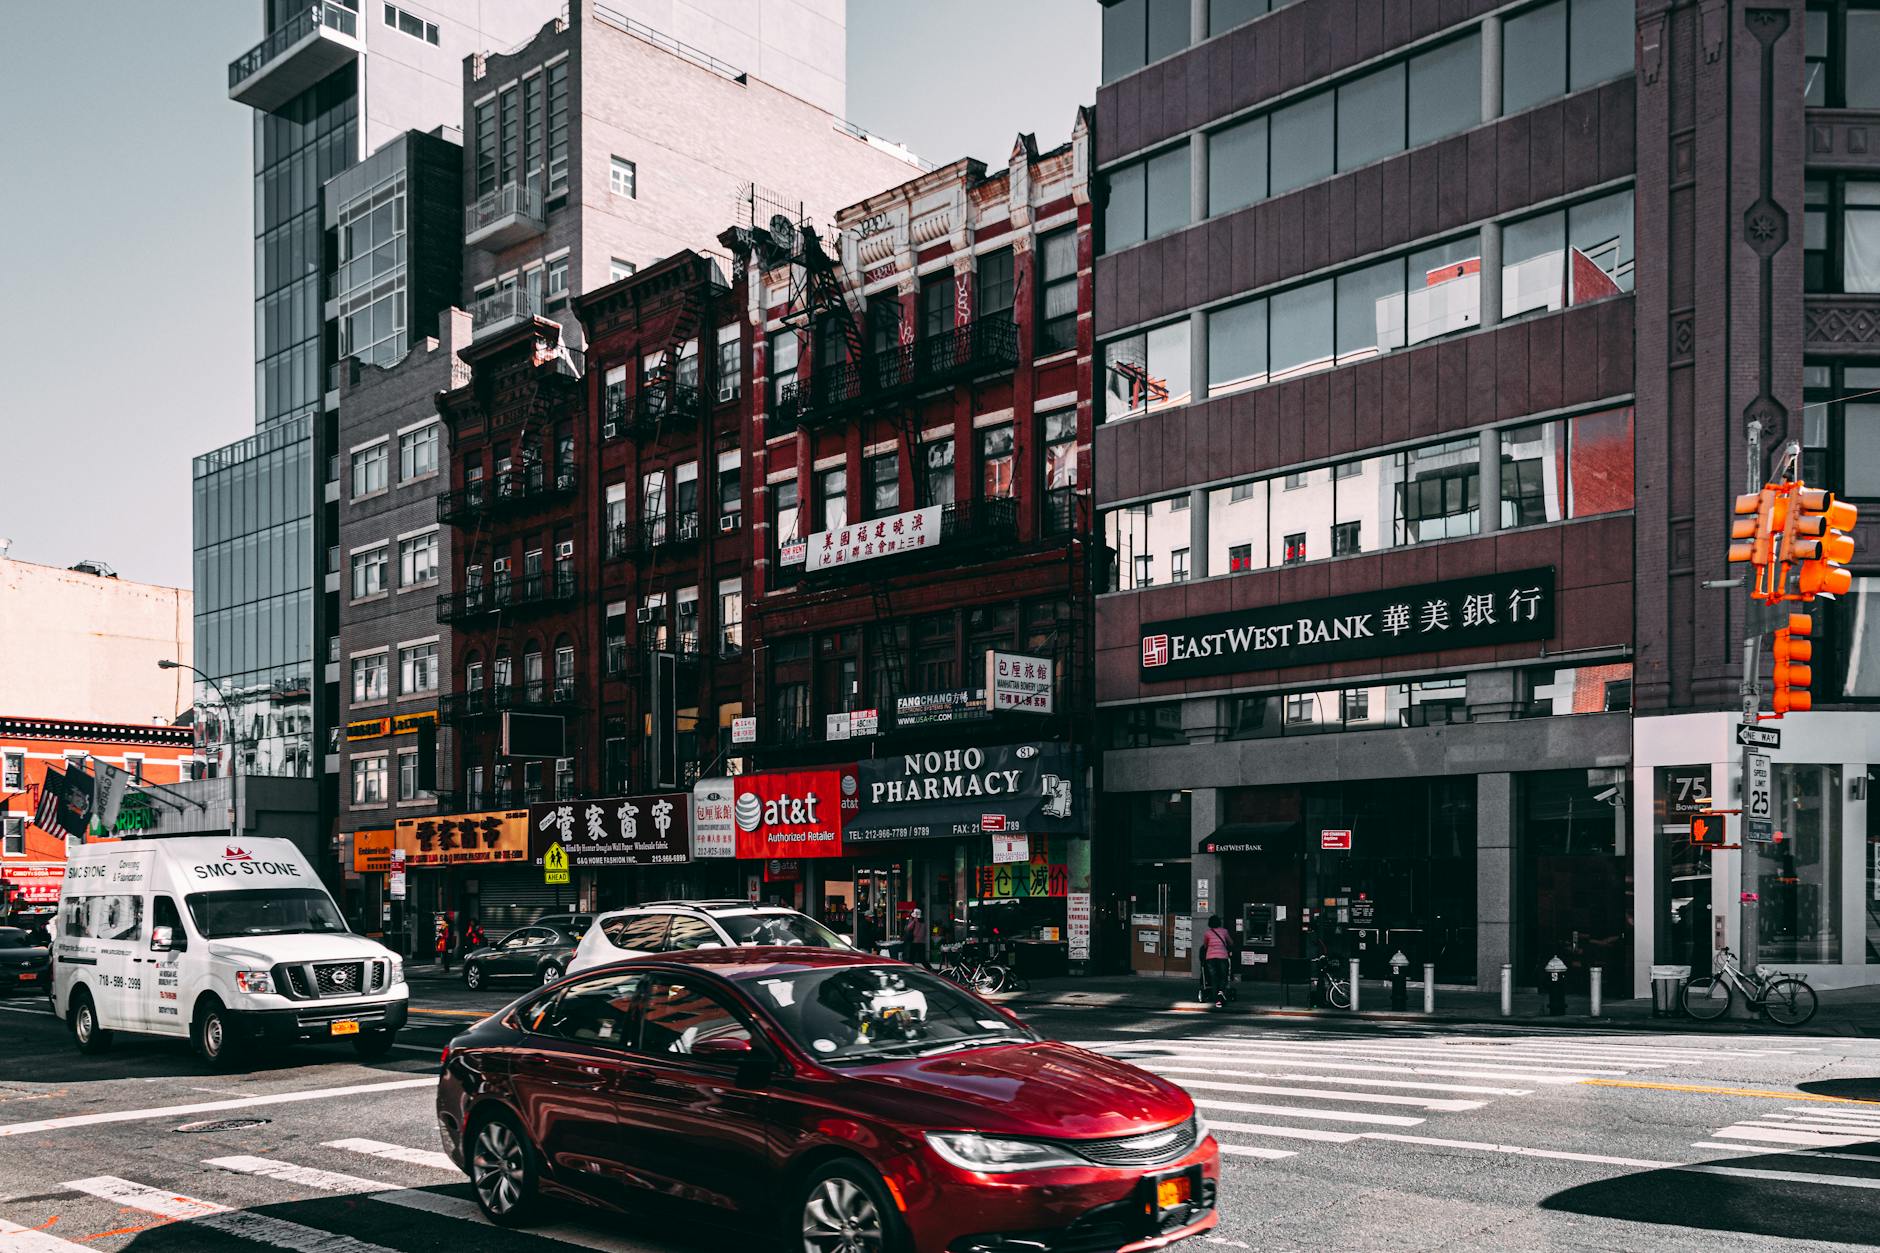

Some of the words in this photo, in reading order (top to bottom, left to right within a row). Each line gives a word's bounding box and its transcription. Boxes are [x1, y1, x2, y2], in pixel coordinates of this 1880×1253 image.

[1382, 587, 1541, 637] 華美銀行
[999, 660, 1048, 680] 包厘旅館
[997, 679, 1019, 689] MANHATTAN
[1020, 681, 1036, 691] BOWERY
[897, 692, 952, 708] FANGCHANG
[1743, 731, 1756, 741] ONE
[1762, 732, 1775, 742] WAY
[1020, 746, 1032, 758] 81
[904, 748, 983, 776] NOHO
[1755, 759, 1765, 767] CITY
[1753, 769, 1768, 778] SPEED
[872, 770, 1021, 804] PHARMACY
[1676, 777, 1707, 801] 75
[764, 792, 819, 826] at&t
[841, 799, 859, 809] at&t
[1752, 790, 1769, 814] 25
[556, 799, 674, 842] 管家窗帘
[849, 830, 863, 840] TEL:
[914, 826, 930, 837] 9789
[952, 823, 970, 834] FAX:
[768, 832, 805, 843] Authorized
[808, 831, 835, 842] Retailer
[588, 856, 603, 864] HOME
[603, 856, 626, 864] FASHION
[68, 867, 82, 879] SMC
[84, 865, 106, 878] STONE
[194, 862, 237, 878] SMC
[240, 861, 301, 877] STONE
[548, 873, 567, 881] AHEAD
